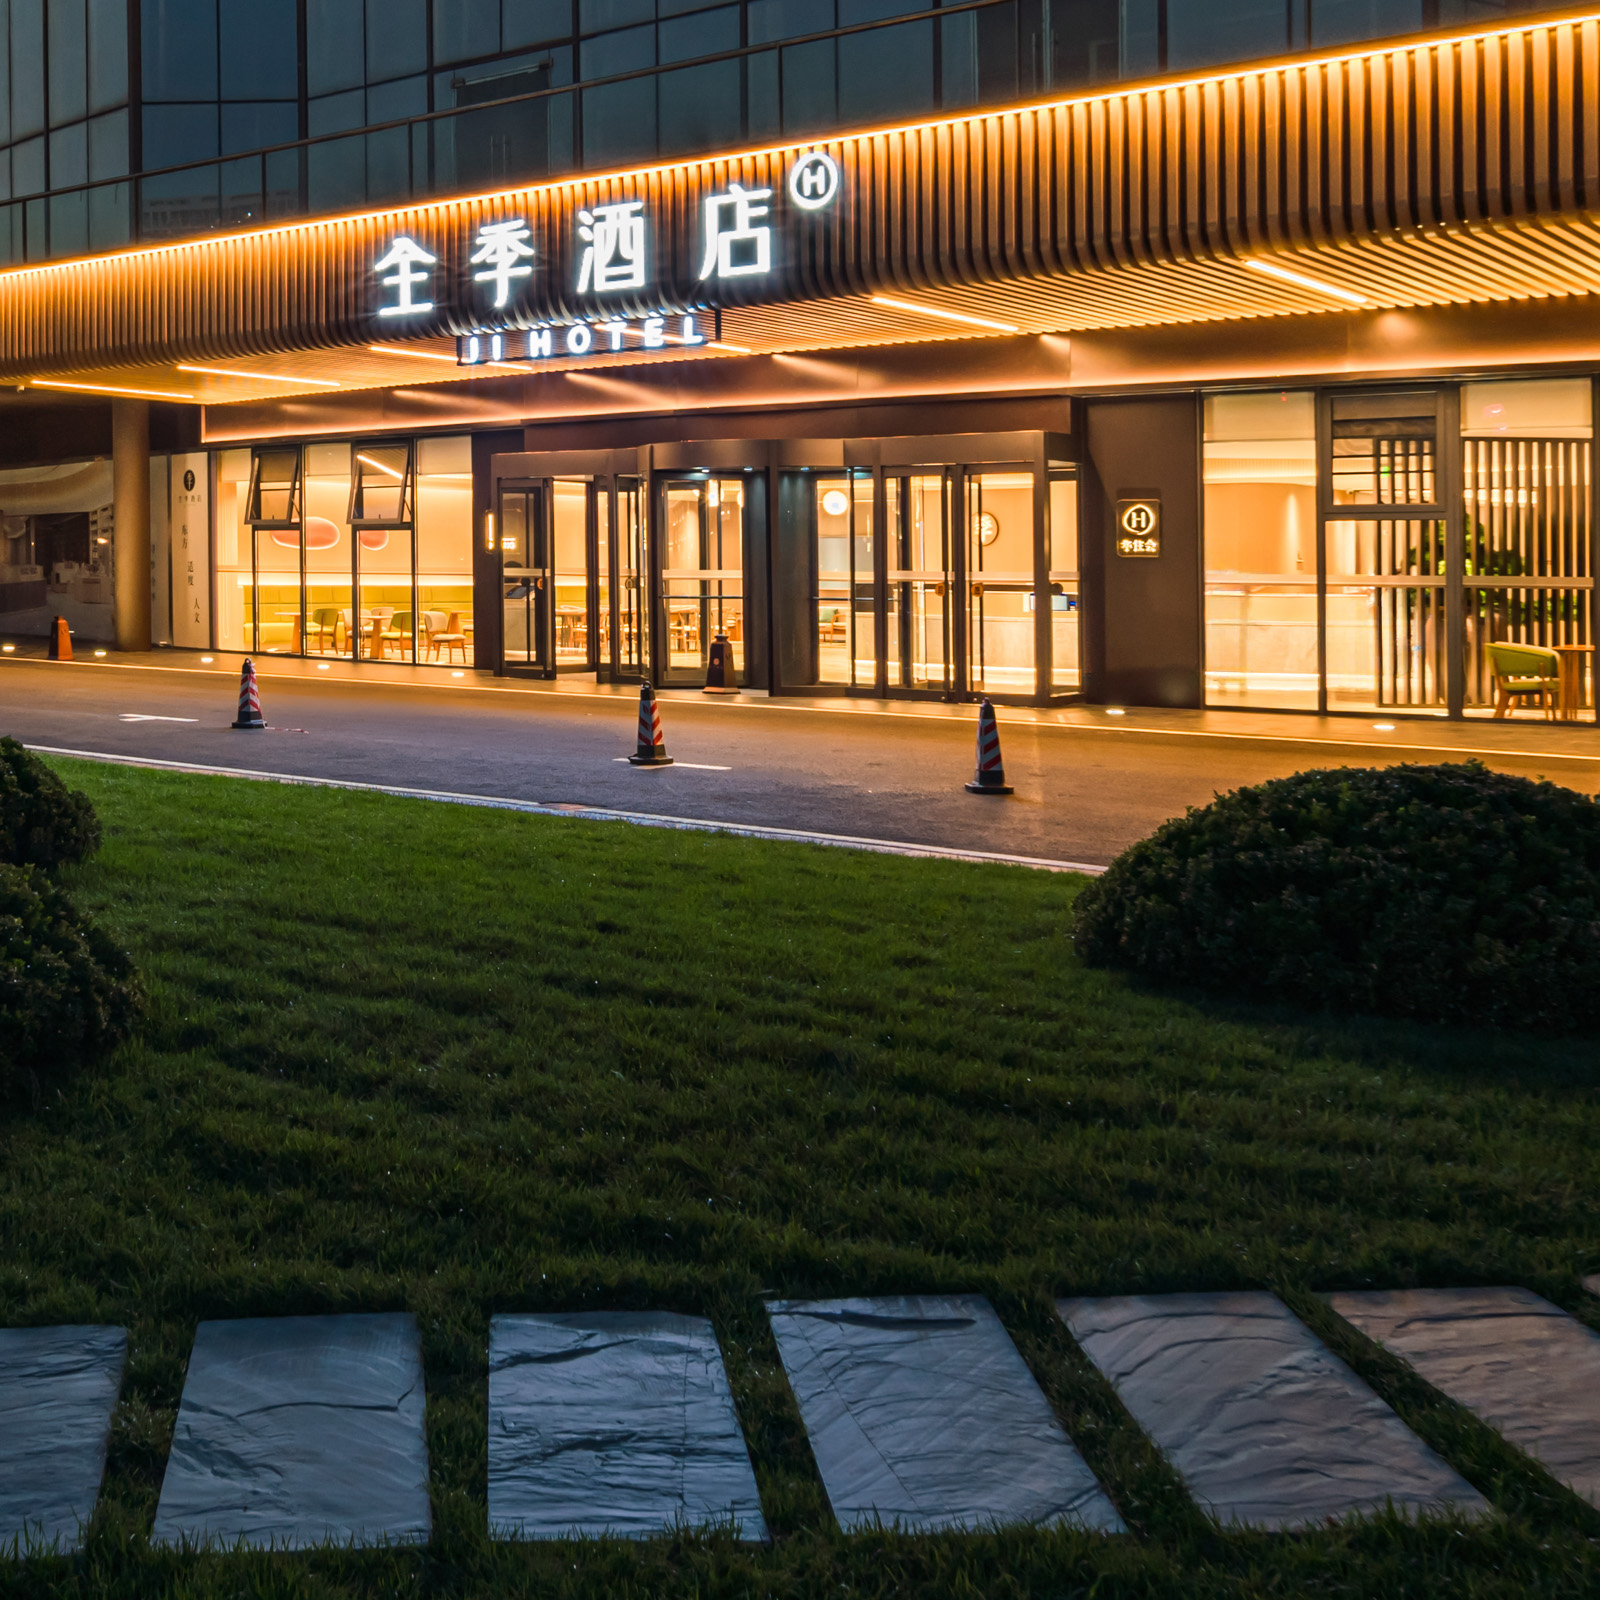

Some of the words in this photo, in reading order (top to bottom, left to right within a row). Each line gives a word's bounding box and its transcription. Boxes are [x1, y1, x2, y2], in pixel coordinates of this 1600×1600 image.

[374, 183, 773, 316] 全季酒店
[469, 334, 502, 364] JI
[529, 316, 704, 358] HOTEL
[194, 598, 200, 623] 人文
